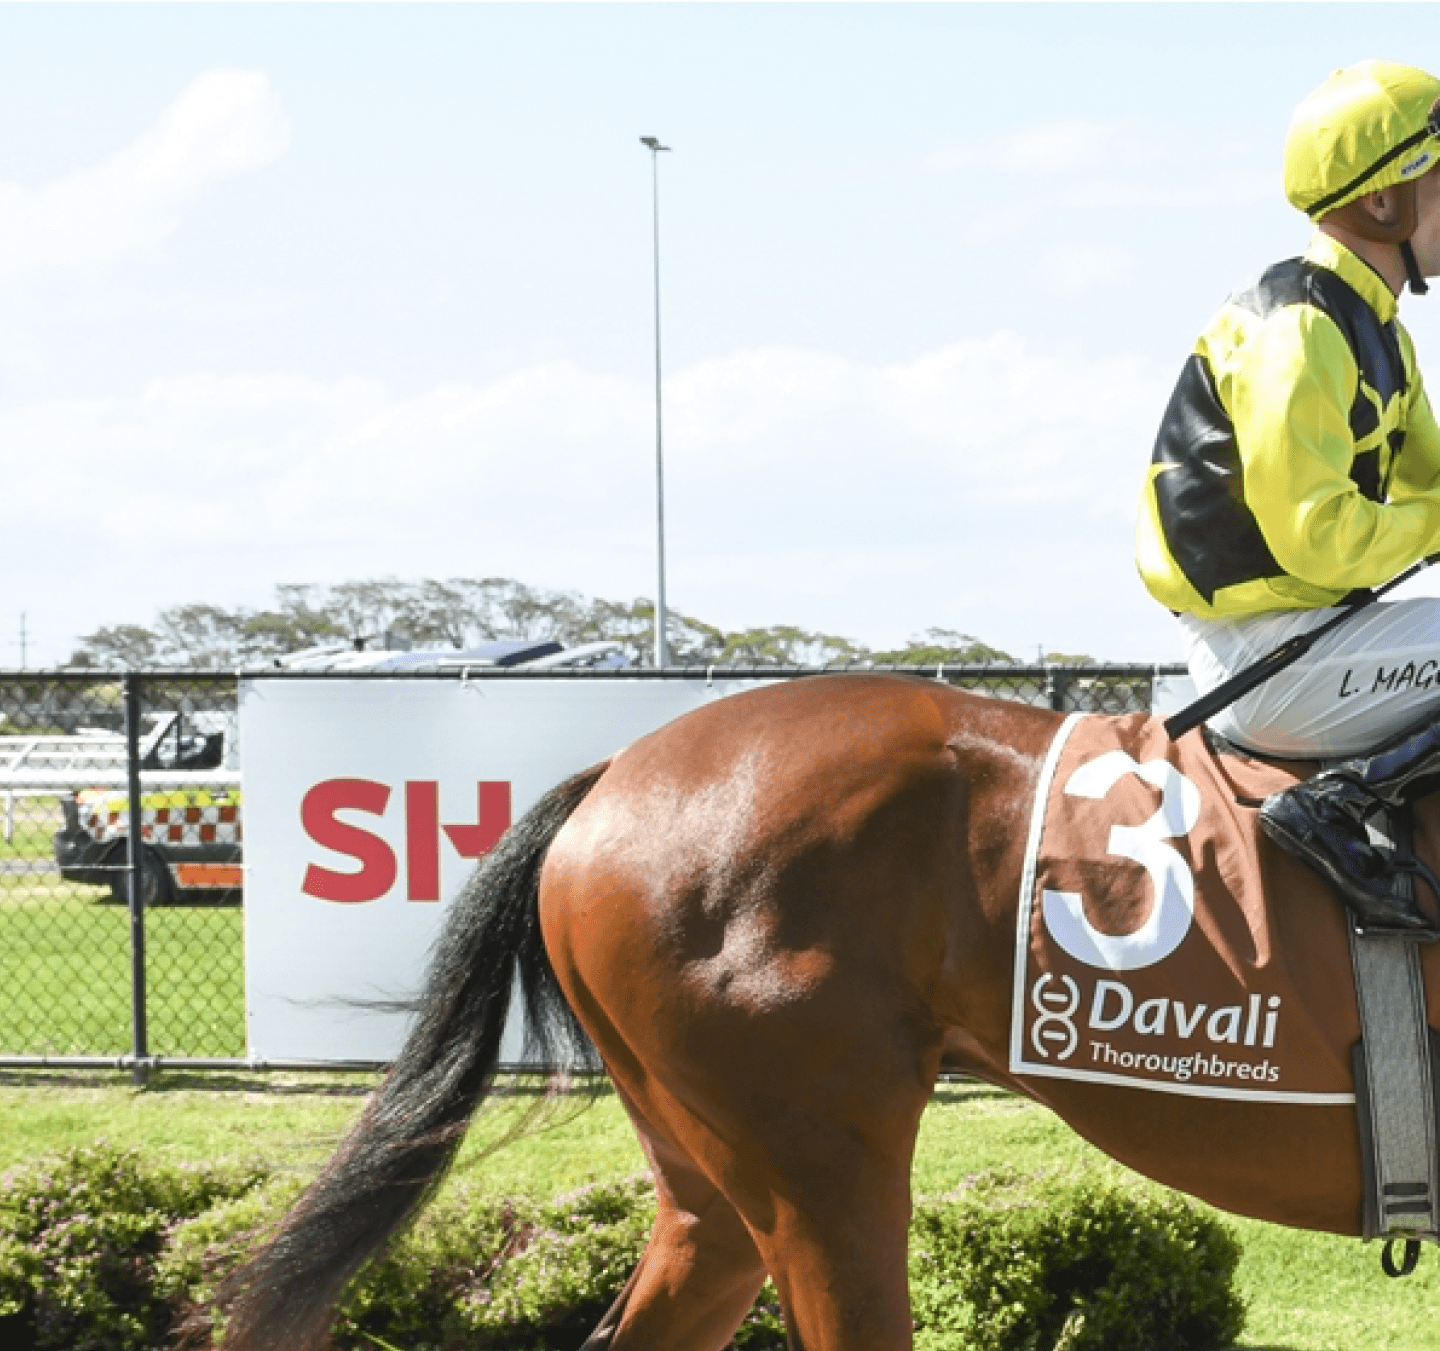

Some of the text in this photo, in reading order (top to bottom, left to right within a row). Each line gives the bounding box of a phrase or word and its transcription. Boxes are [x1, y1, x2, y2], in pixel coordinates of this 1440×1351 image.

[1338, 669, 1360, 698] L.
[1042, 750, 1200, 970] 3
[1088, 979, 1282, 1048] Davali
[1088, 1039, 1281, 1082] Thoroughbreds
